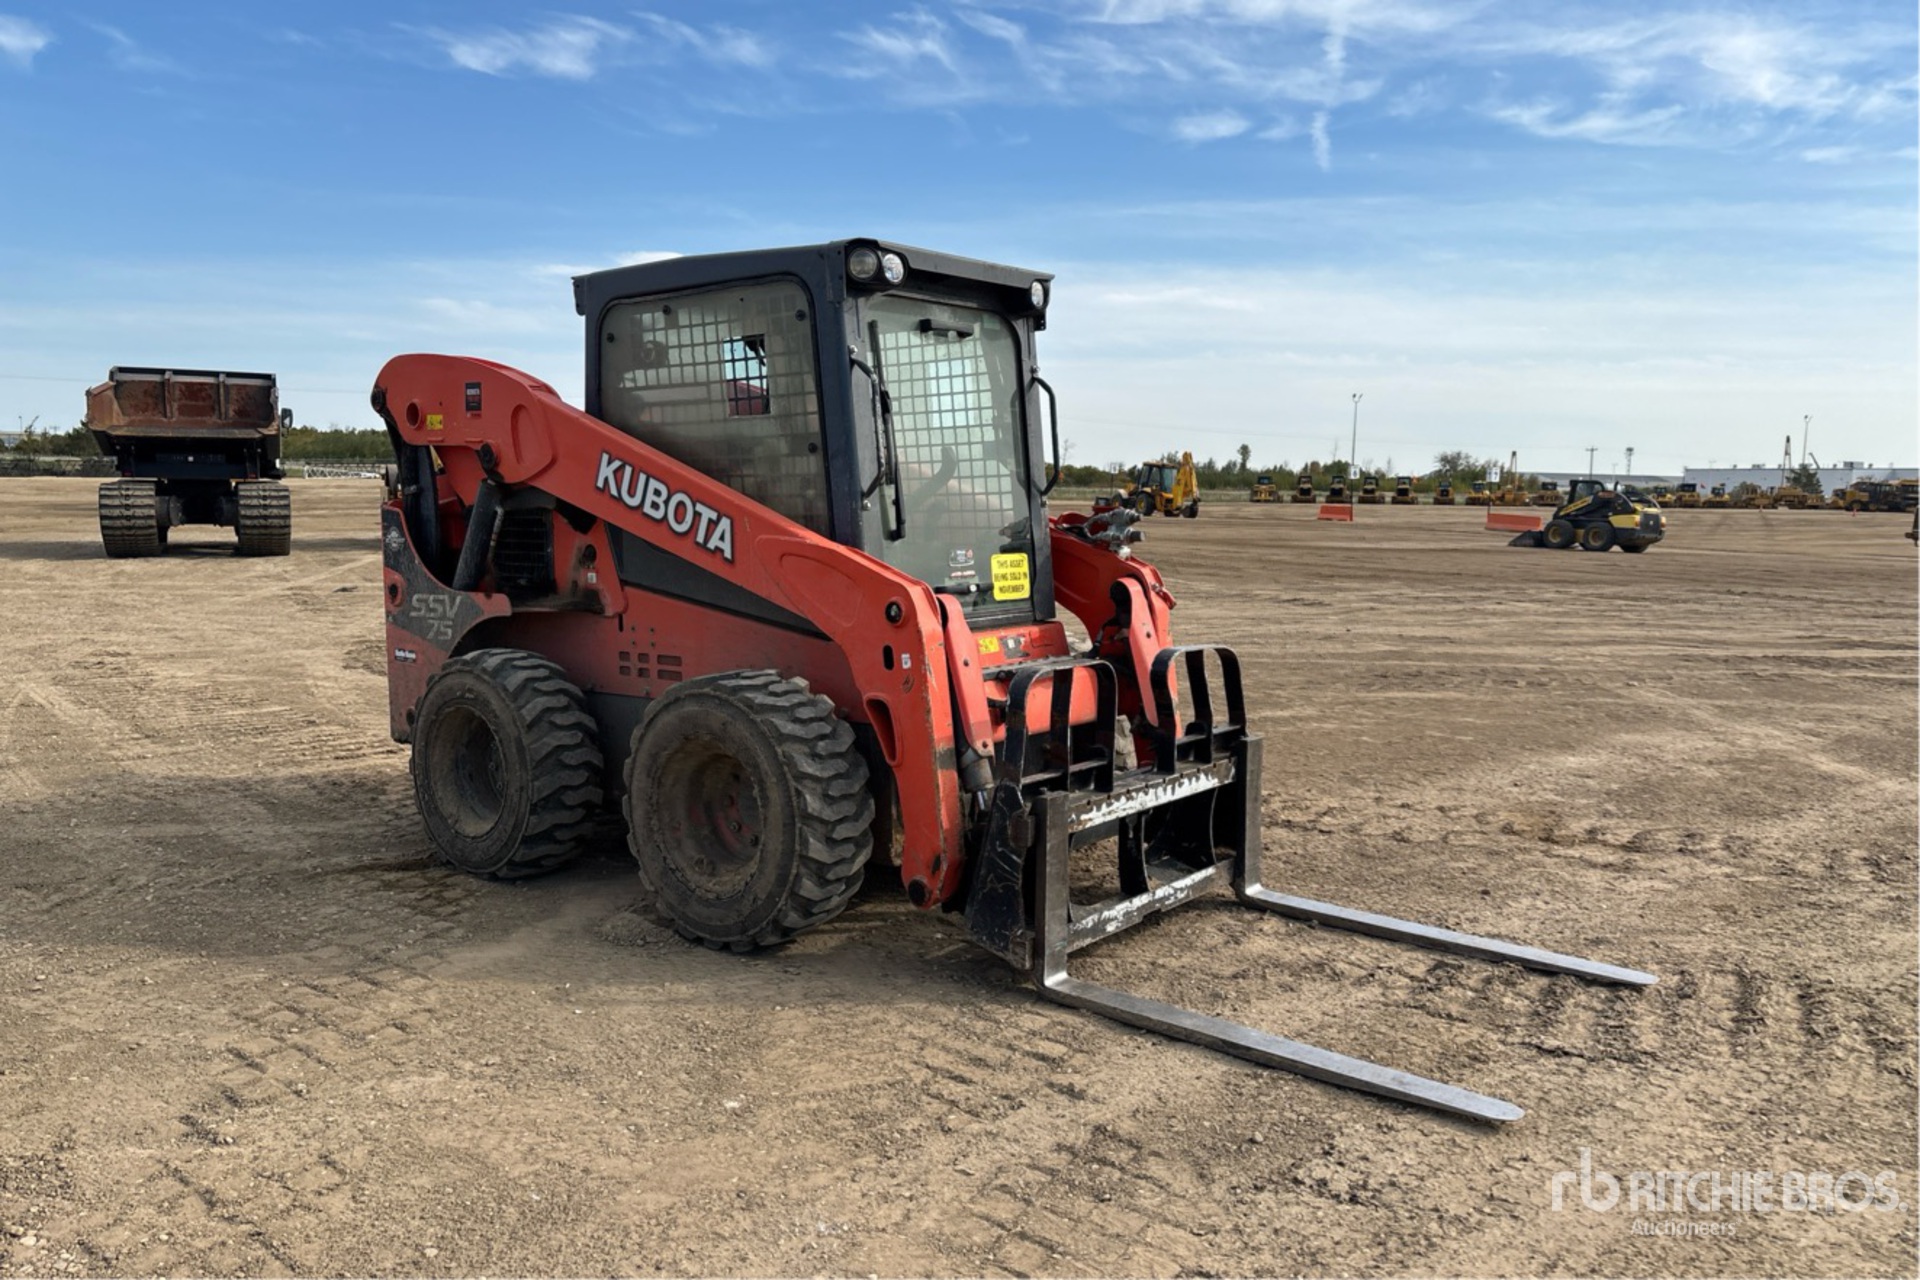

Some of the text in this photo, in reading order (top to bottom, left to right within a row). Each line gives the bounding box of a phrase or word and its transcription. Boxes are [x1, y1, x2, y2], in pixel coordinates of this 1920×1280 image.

[595, 451, 733, 561] KUBOTA
[998, 584, 1025, 594] NOVEMBER
[409, 593, 463, 618] SSV
[427, 620, 454, 640] 75
